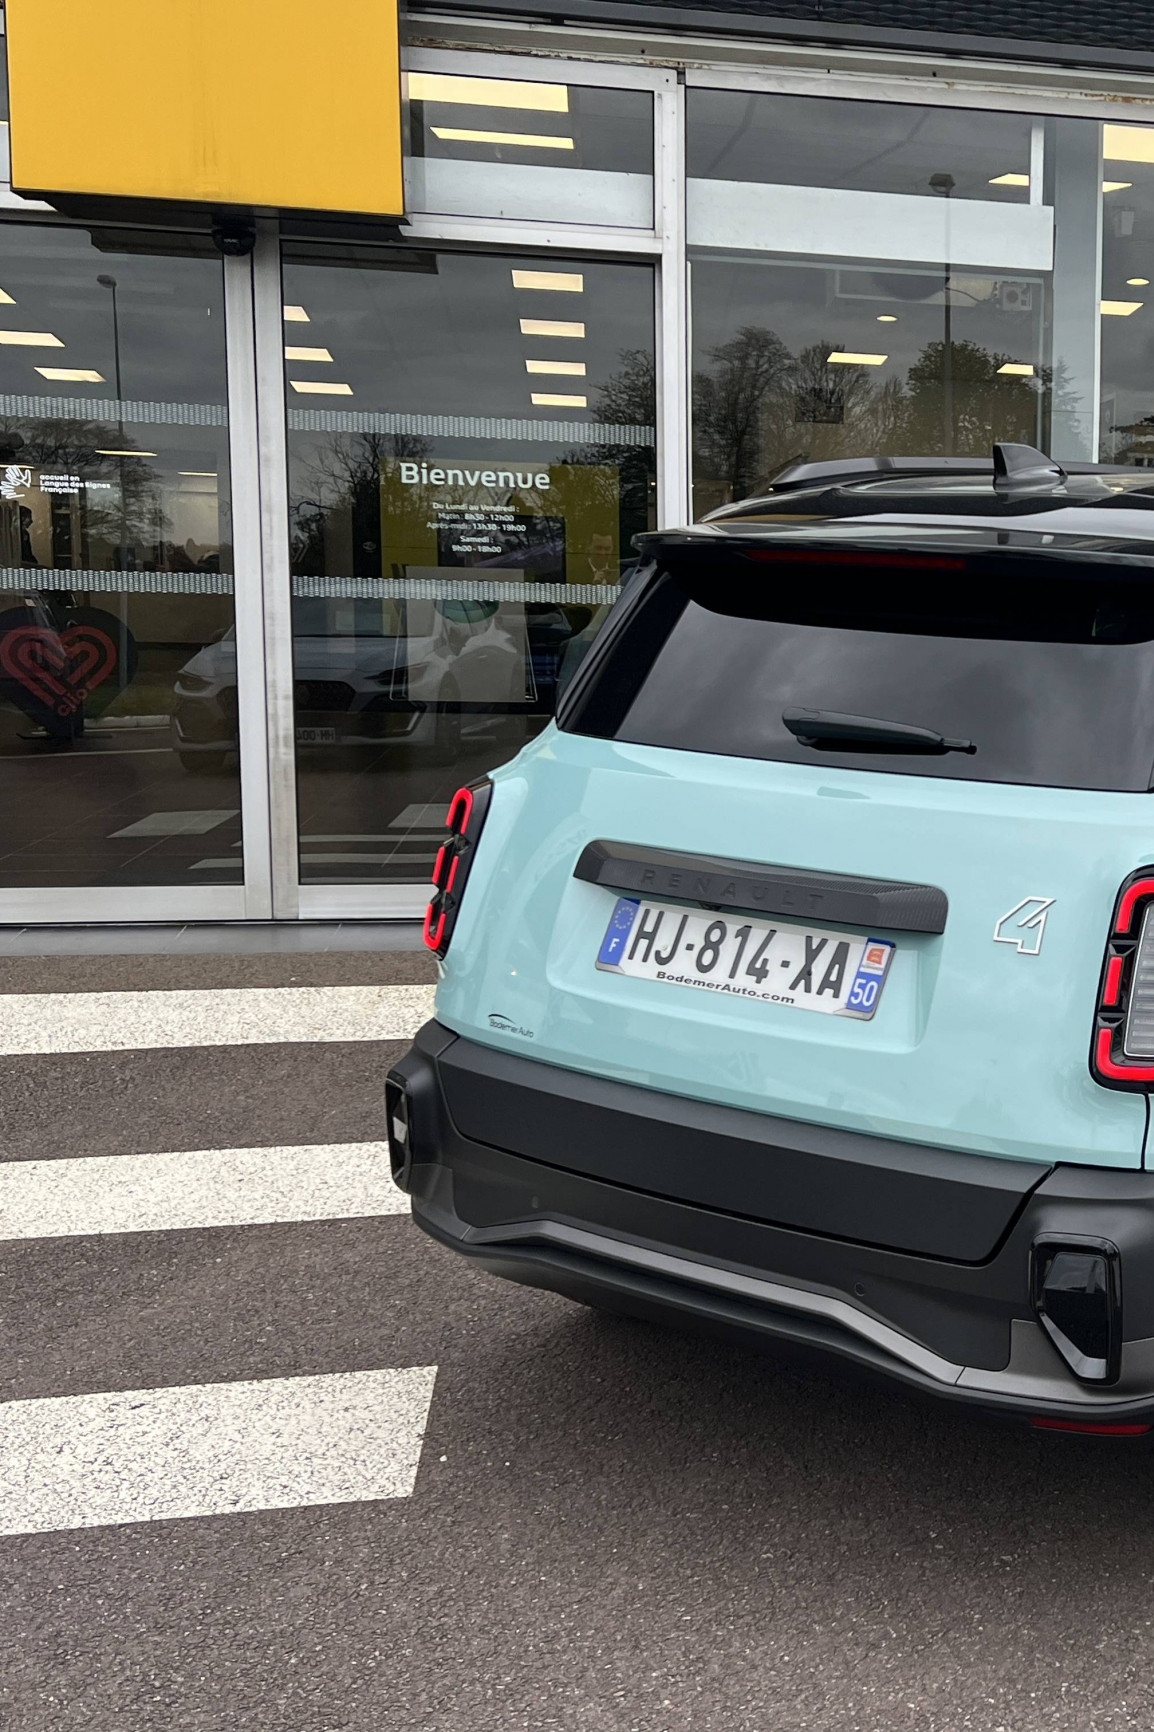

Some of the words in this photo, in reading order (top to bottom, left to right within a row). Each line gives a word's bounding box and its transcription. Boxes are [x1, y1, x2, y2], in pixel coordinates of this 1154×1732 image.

[40, 480, 69, 488] Langue
[400, 462, 550, 489] Bienvenue
[432, 502, 444, 510] Du
[446, 503, 468, 511] Lundi
[481, 505, 515, 513] Vendredi
[490, 514, 515, 522] 12h00
[473, 523, 497, 531] 13h30
[502, 524, 527, 532] 19h00
[639, 868, 825, 912] RENAULT
[609, 938, 619, 953] F
[628, 908, 850, 999] HJ-814-XA
[656, 971, 795, 1004] BodemerAuto.com
[850, 978, 878, 1007] 50
